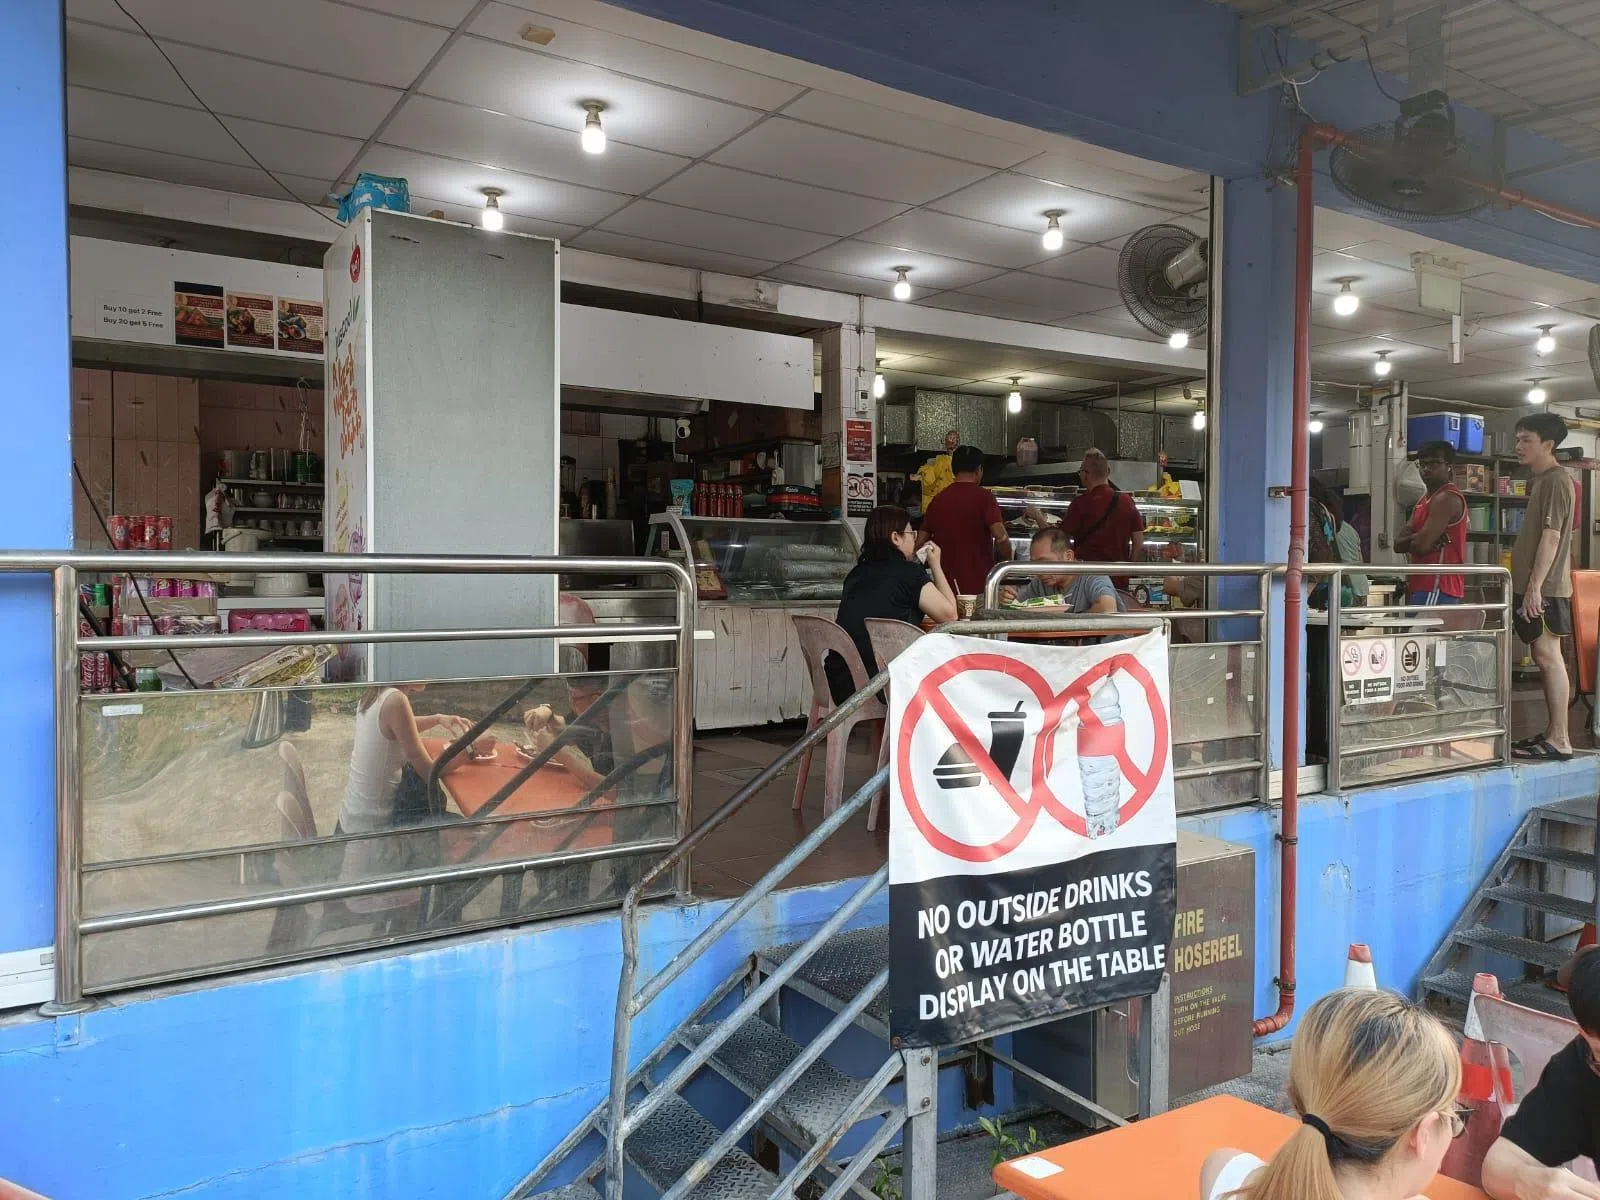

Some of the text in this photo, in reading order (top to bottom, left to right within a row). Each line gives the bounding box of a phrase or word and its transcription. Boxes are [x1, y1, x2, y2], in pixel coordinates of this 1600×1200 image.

[104, 317, 117, 325] Buy
[918, 870, 1153, 940] NO OUTSIDE DRINKS
[1174, 908, 1205, 939] FIRE
[935, 910, 1148, 980] OR WATER BOTTLE
[1174, 933, 1243, 973] HOSEREEL
[919, 944, 1166, 1021] DISPLAY ON THE TABLE
[1174, 985, 1213, 1004] INSTRUCTIONS
[1174, 1004, 1189, 1015] TURN
[1190, 1002, 1198, 1010] ON
[1200, 998, 1210, 1006] THE
[1174, 1013, 1195, 1026] BEFORE
[1174, 1028, 1185, 1038] OUT
